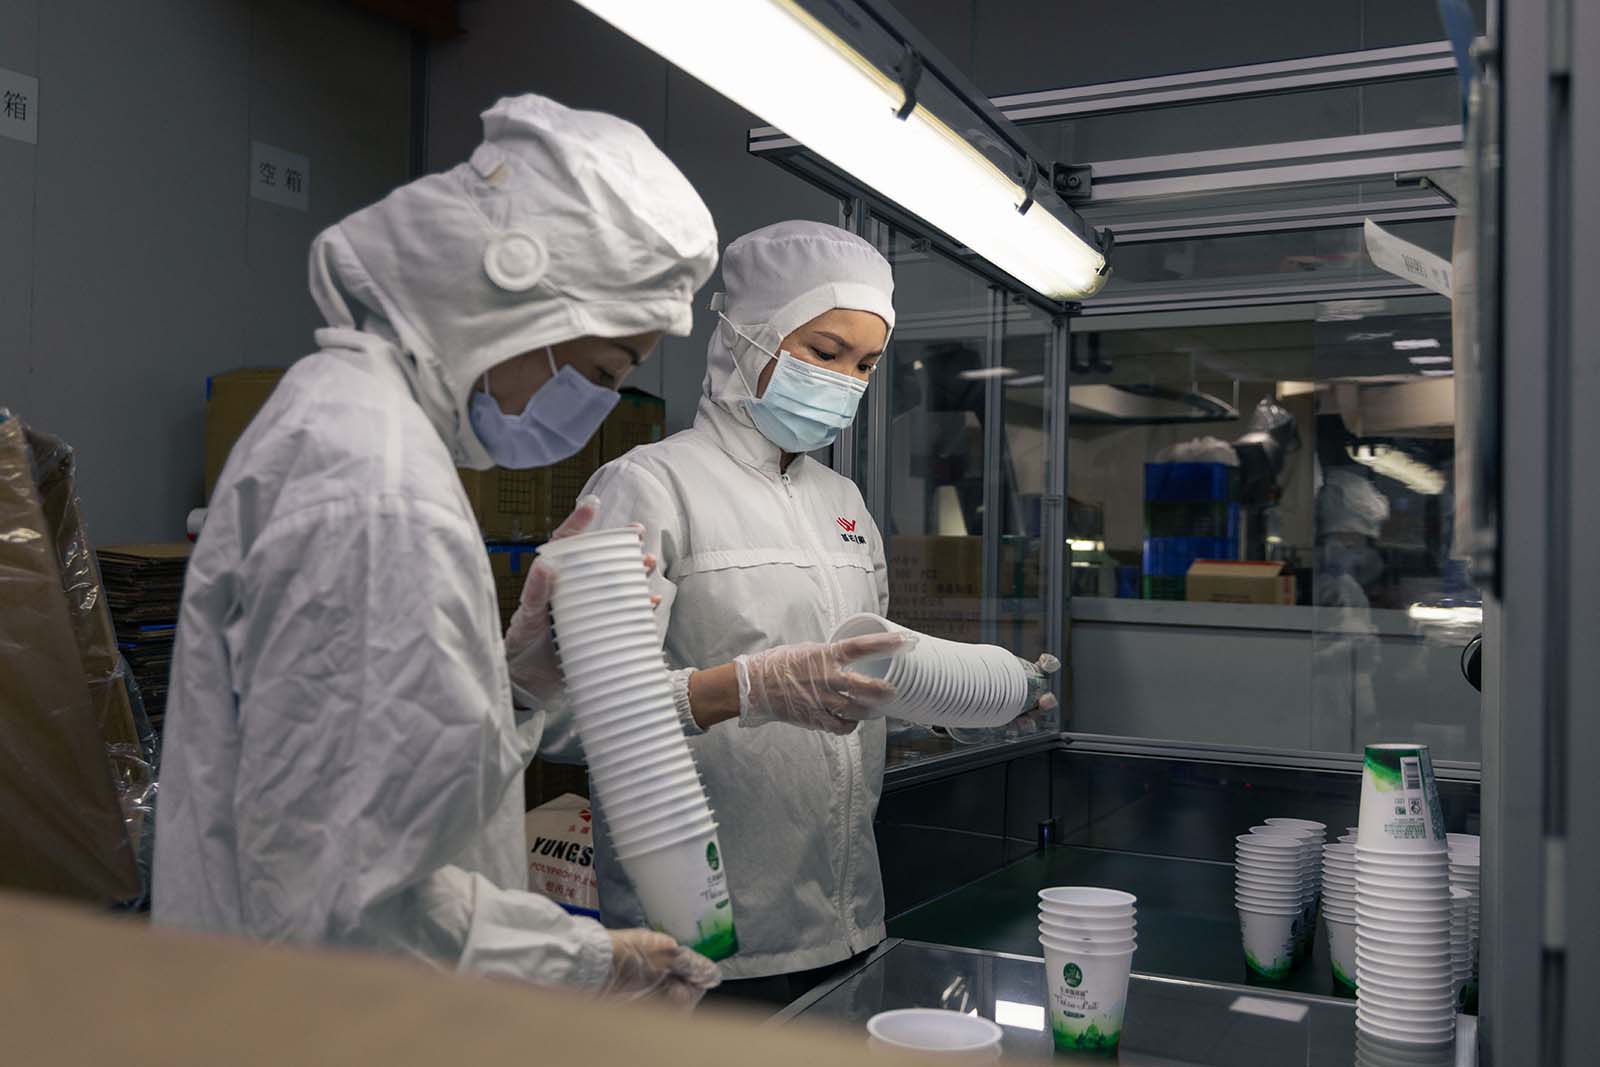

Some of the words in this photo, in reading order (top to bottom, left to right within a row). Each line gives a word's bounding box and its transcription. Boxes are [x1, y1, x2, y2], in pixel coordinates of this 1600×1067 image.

[3, 89, 27, 121] 箱
[259, 161, 303, 193] 空箱
[531, 836, 596, 870] YUNGS
